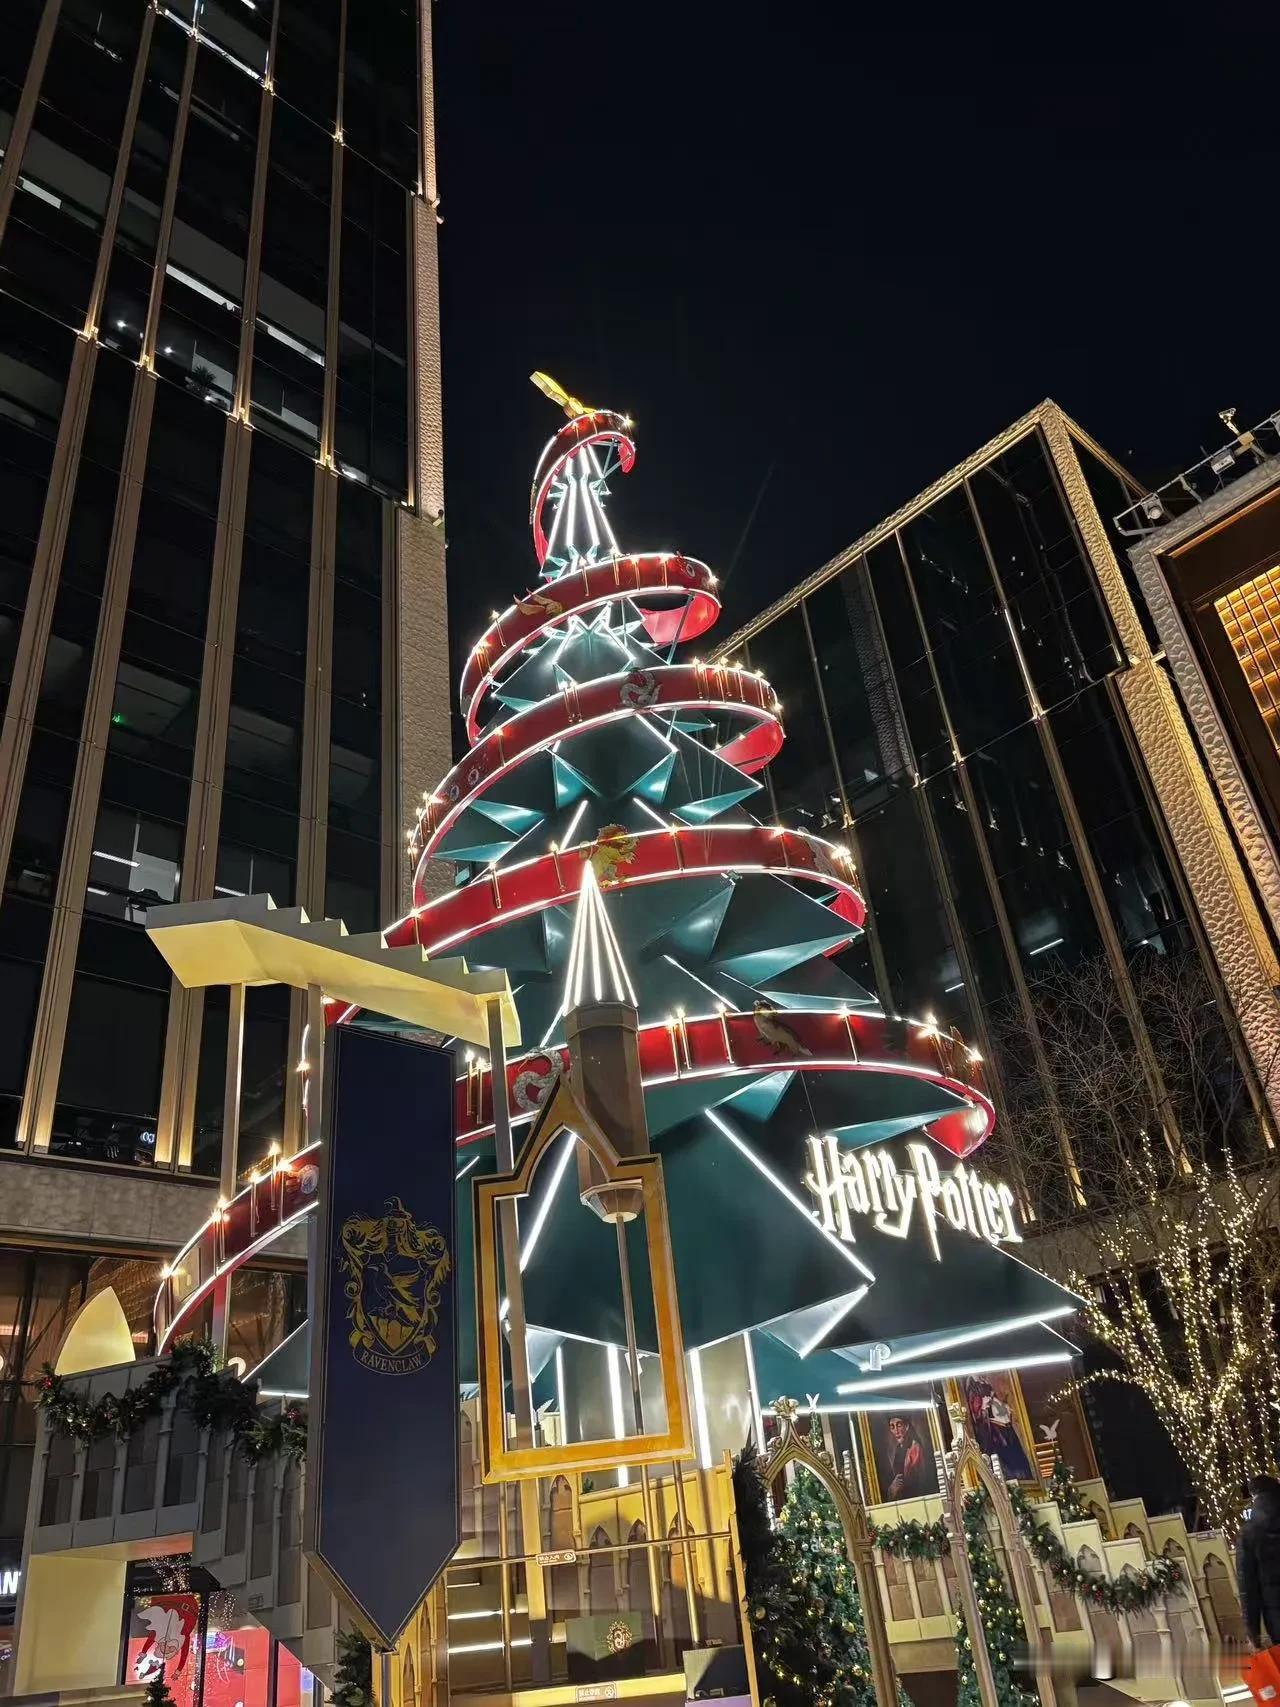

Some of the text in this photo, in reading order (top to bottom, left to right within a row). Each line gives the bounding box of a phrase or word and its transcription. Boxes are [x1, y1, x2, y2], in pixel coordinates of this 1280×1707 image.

[804, 1134, 1023, 1262] Harry Potter
[360, 1350, 421, 1373] RAVENCLAW
